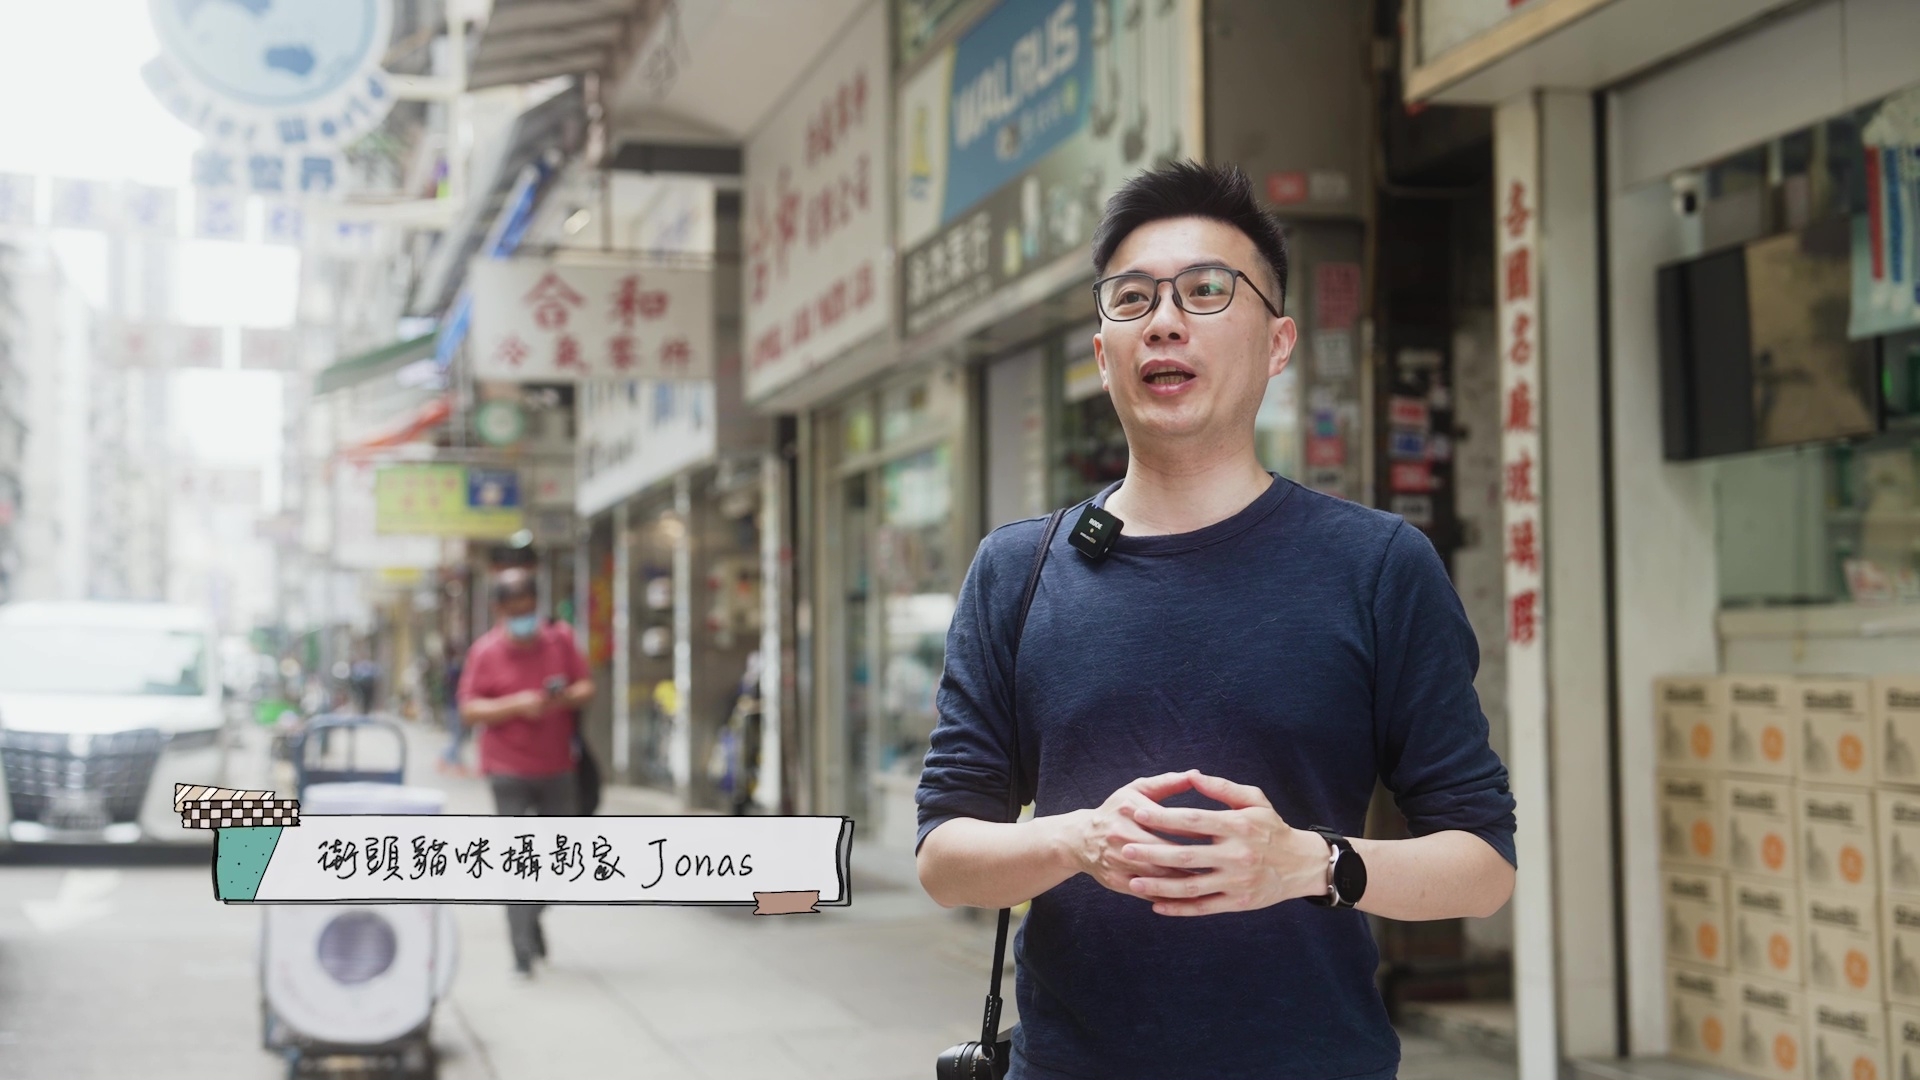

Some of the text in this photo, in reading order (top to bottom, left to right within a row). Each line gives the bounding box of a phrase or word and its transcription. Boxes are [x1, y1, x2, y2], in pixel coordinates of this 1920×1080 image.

[953, 1, 1078, 148] WALRUS
[522, 270, 670, 330] 合和
[494, 333, 692, 374] 冷氣零件
